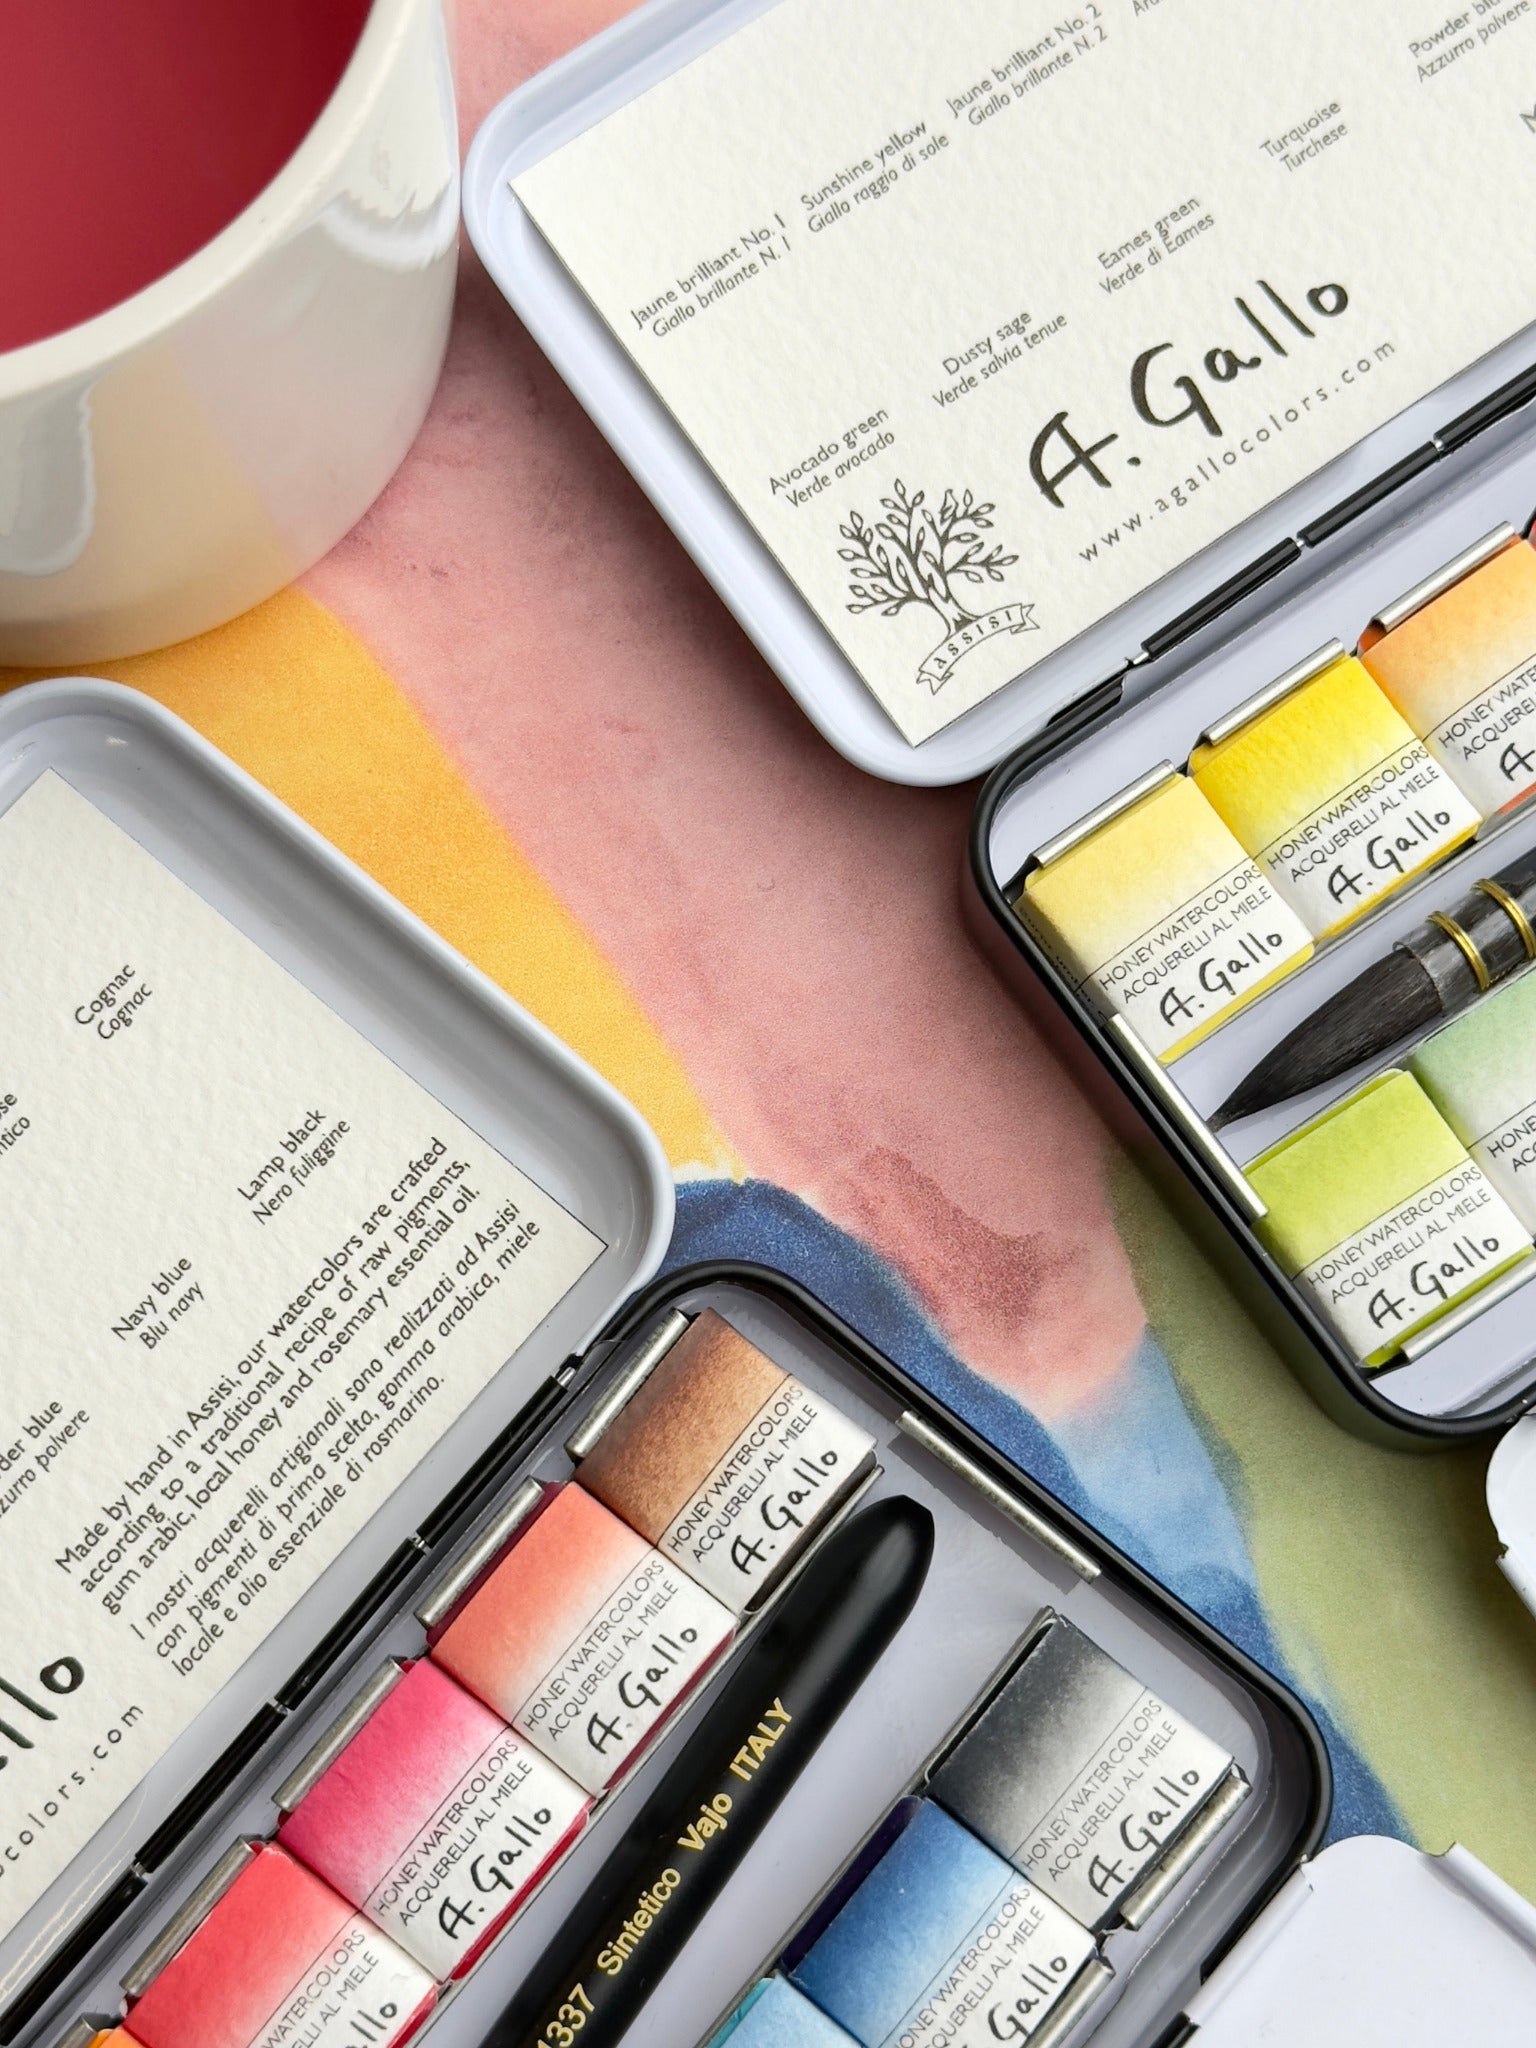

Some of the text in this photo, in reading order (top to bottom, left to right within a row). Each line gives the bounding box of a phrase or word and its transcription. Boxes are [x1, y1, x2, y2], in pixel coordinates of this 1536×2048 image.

[945, 79, 993, 120] Jaune
[990, 35, 1056, 83] brilliant
[1053, 18, 1089, 41] No.
[1084, 0, 1102, 20] 2
[967, 24, 1108, 126] Giallo brillante N. 2
[1408, 11, 1470, 58] Powder
[1416, 0, 1534, 83] Azzurro polvere
[800, 121, 927, 211] Sunshine yellow
[1258, 101, 1341, 157] Turquoise
[1278, 122, 1348, 172] Turchese
[807, 134, 949, 233] Giallo raggio di sole
[629, 290, 678, 331] Jaune
[675, 246, 742, 294] brilliant
[739, 228, 776, 252] No.
[1096, 197, 1200, 270] Eames green
[1098, 213, 1215, 295] Verde di Eames
[652, 304, 696, 337] Giallo
[695, 262, 759, 309] brillante
[758, 245, 781, 267] N.
[931, 314, 1067, 408] Verde salvia tenue
[941, 312, 1032, 376] Dusty sage
[1129, 279, 1349, 438] Gallo
[768, 409, 889, 496] Avocado green
[784, 431, 895, 508] Verde avocado
[1077, 342, 1395, 562] www.agallocolors.com
[1266, 745, 1429, 871] HONEY WATERCOLORS
[1290, 765, 1440, 883] ACQUERELLI AL MIELE
[1366, 809, 1451, 874] Gallo
[1098, 940, 1155, 991] HONEY
[1152, 864, 1268, 947] WATERCOLORS
[1122, 884, 1272, 1004] ACQUERELLI AL MIELE
[1198, 931, 1283, 996] Gallo
[73, 963, 136, 1025] Cognac
[96, 982, 153, 1040] Cognac
[236, 1109, 327, 1201] Lamp black
[251, 1120, 351, 1226] Nero fuliggine
[1306, 1165, 1482, 1293] HONEY WATERCOLORS
[1331, 1187, 1491, 1305] ACQUERELLI AL MIELE
[1409, 1235, 1500, 1301] Gallo
[110, 1257, 192, 1341] Navy blue
[138, 1281, 205, 1350] Blu navy
[53, 1136, 448, 1574] Made by hand in Assisi, our watercolors are crafted
[79, 1159, 471, 1593] according to a traditional recipe of raw pigments,
[101, 1183, 480, 1616] gum arabic, local honey and rosemary essential oil.
[22, 1401, 63, 1439] blue
[34, 1409, 90, 1473] polvere
[145, 1569, 194, 1628] nostri
[193, 1484, 269, 1573] acquerelli
[269, 1396, 346, 1488] artigianali
[344, 1358, 384, 1402] sono
[383, 1271, 456, 1357] realizzati
[455, 1244, 480, 1276] ad
[473, 1198, 521, 1253] Assisi
[156, 1221, 540, 1658] con pigmenti di prima scelta, gomma arabica, miele
[666, 1385, 803, 1554] HONEY WATERCOLORS
[691, 1403, 818, 1565] ACQUERELLI AL MIELE
[759, 1449, 838, 1531] Gallo
[170, 1376, 445, 1677] locale e olio essenziale di rosmarino.
[372, 1739, 519, 1918] HONEY WATERCOLORS
[1020, 1699, 1162, 1871] HONEY WATERCOLORS
[1047, 1720, 1177, 1883] ACQUERELLI AL MIELE
[1119, 1769, 1200, 1852] Gallo
[398, 1759, 533, 1927] ACQUERELLI AL MIELE
[469, 1807, 552, 1893] Gallo
[596, 1868, 681, 1976] Sintetico
[676, 1793, 733, 1850] Vajo
[729, 1696, 792, 1781] ITALY
